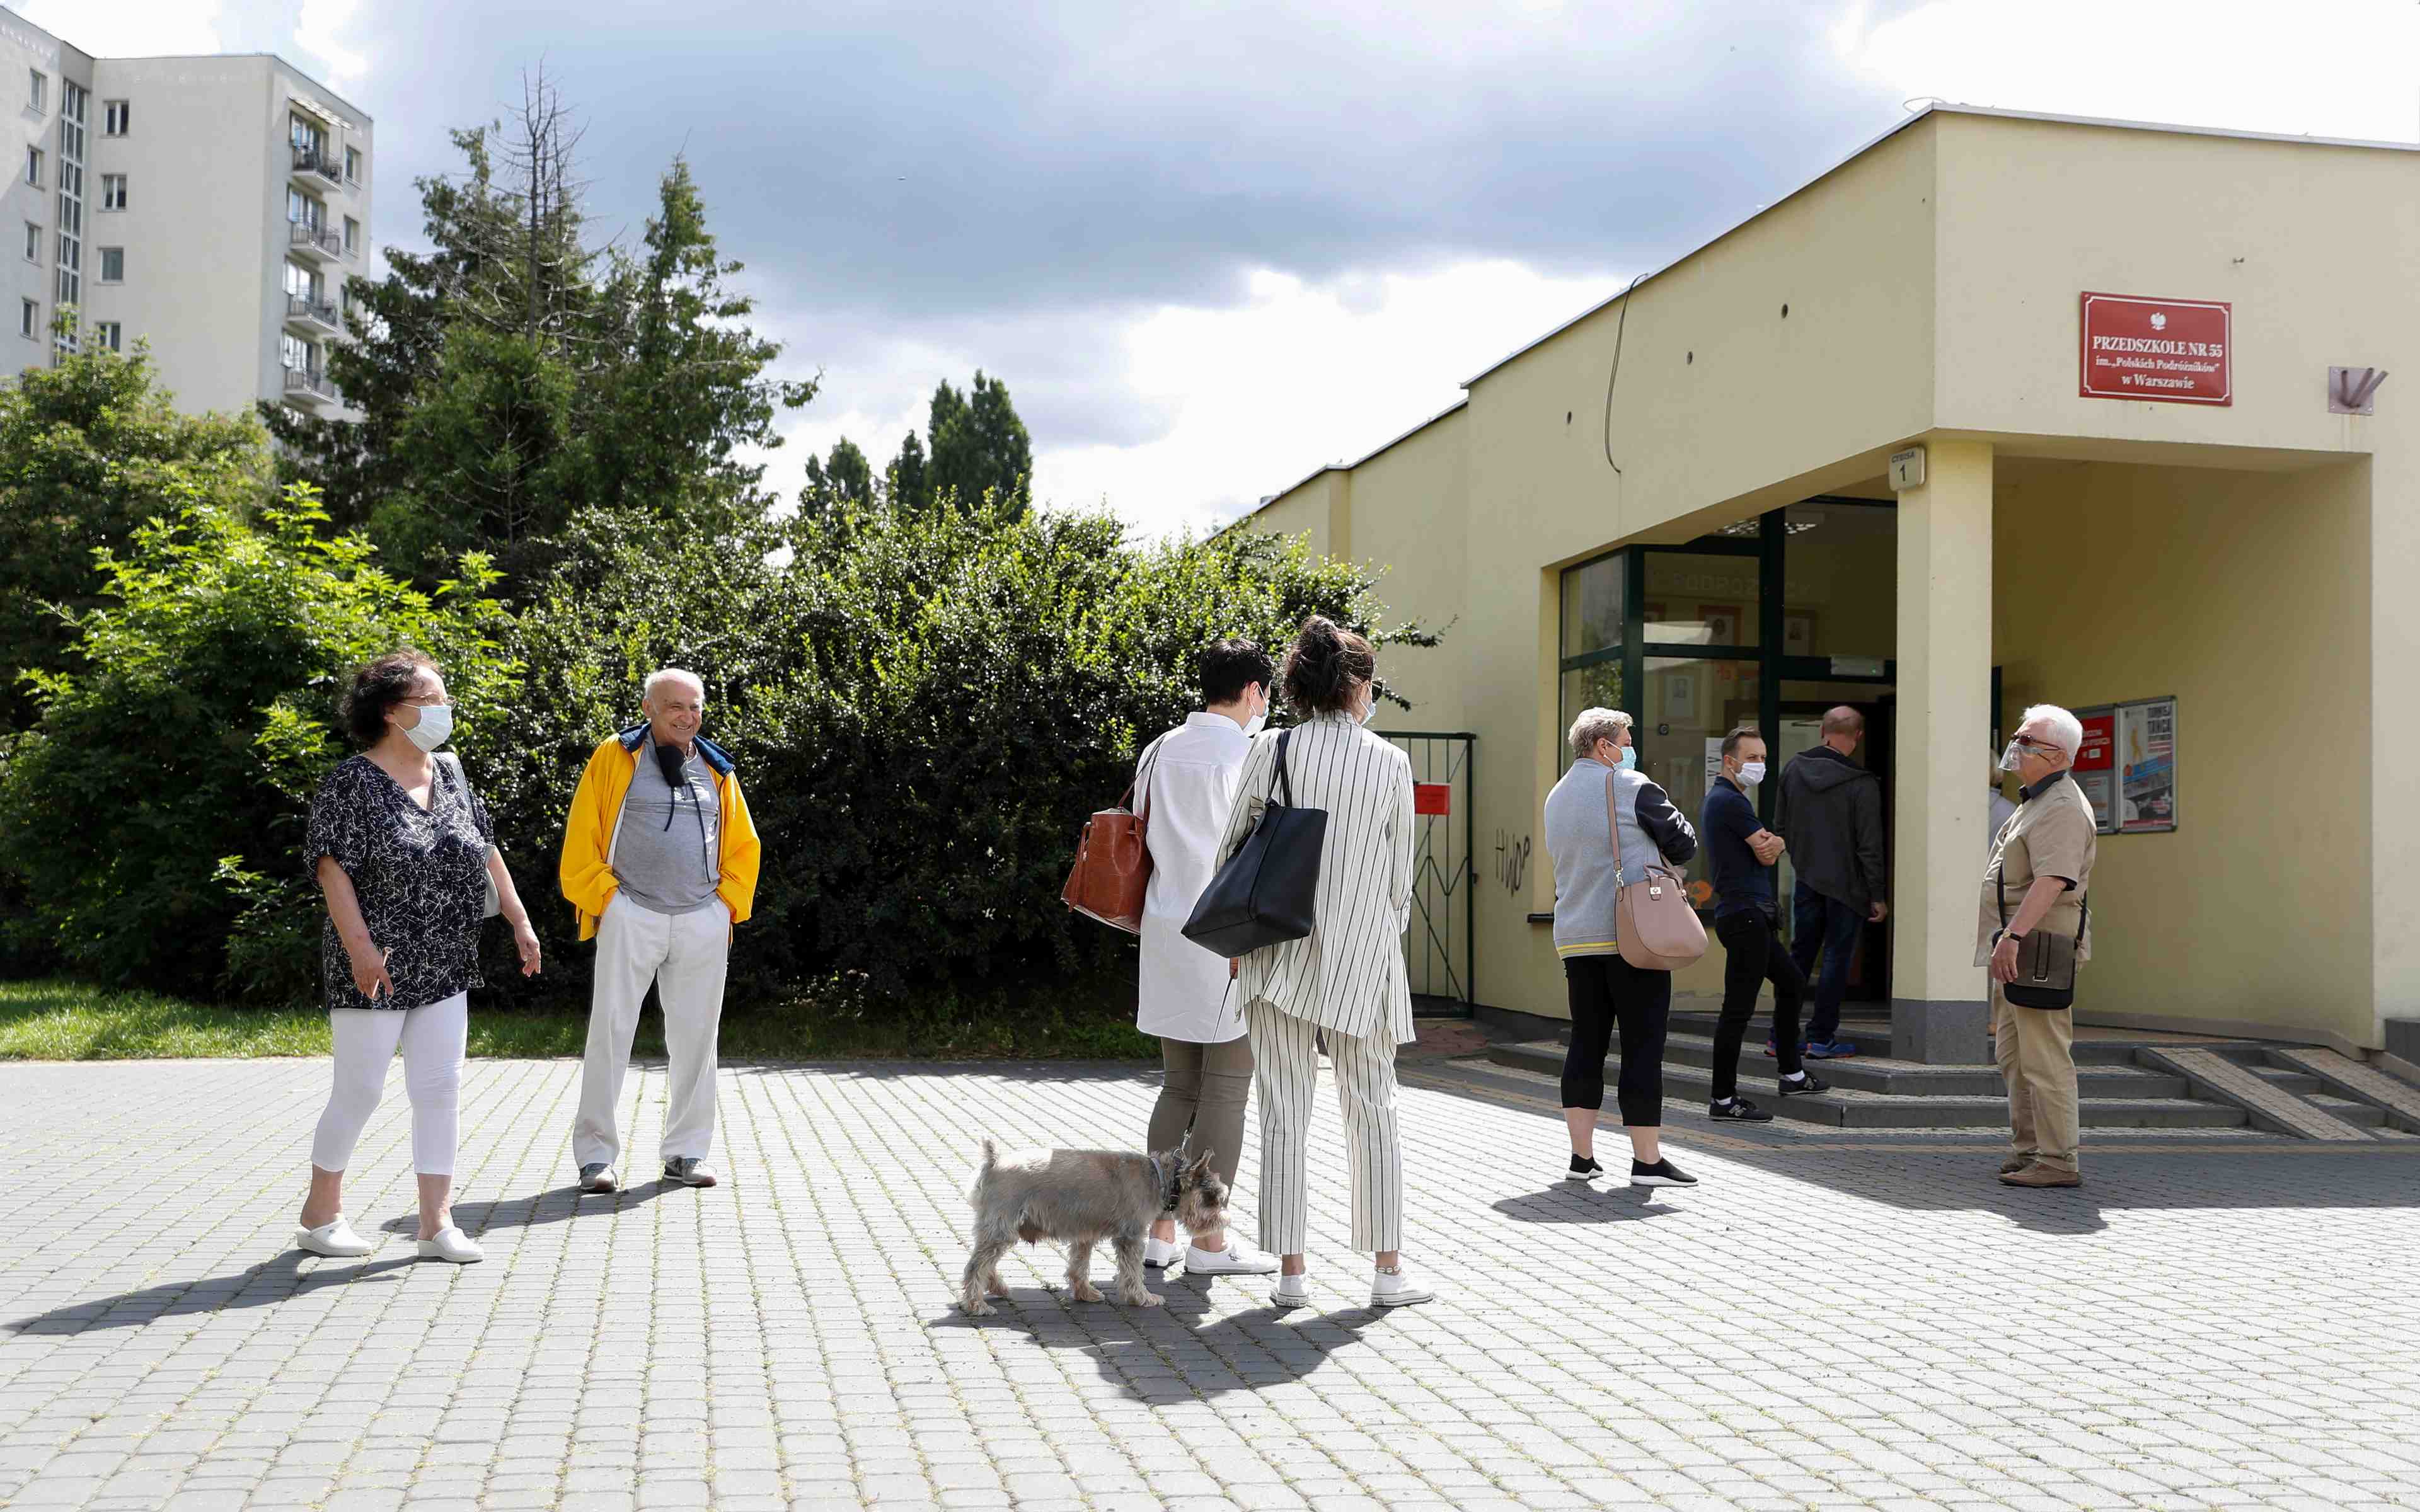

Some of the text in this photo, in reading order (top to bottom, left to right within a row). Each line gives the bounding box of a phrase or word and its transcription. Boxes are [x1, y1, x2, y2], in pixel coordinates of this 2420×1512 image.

[2092, 335, 2187, 356] PRZEDSZKOLE
[2187, 341, 2208, 357] NR
[2121, 373, 2195, 389] w Warszawie
[1899, 464, 1906, 482] 1
